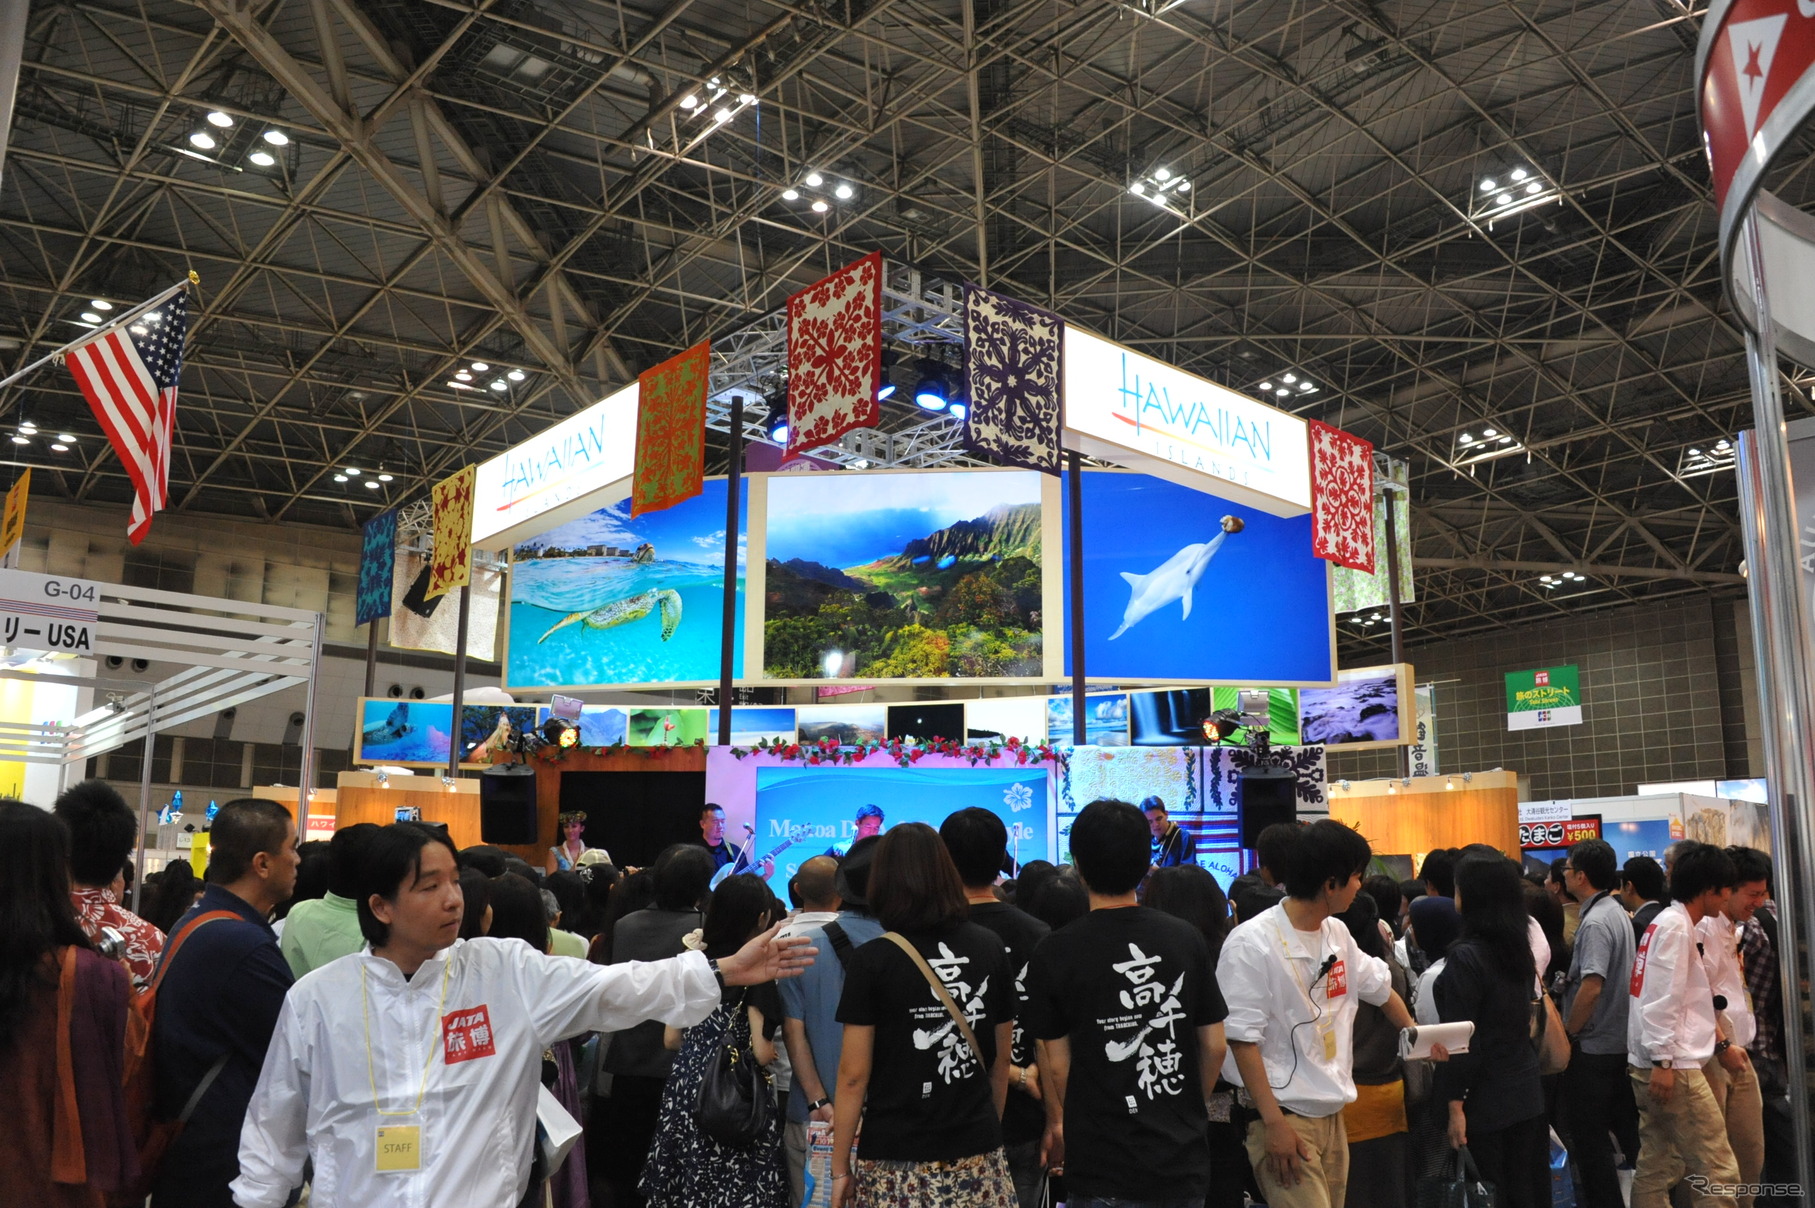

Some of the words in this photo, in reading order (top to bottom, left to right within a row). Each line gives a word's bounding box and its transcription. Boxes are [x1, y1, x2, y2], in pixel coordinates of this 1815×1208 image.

[1118, 352, 1271, 461] HAWAIIAN
[502, 413, 605, 514] HAWAIIAN
[1156, 441, 1249, 486] ISLANDS
[44, 580, 95, 602] G-04
[48, 623, 89, 650] USA
[1567, 829, 1596, 842] ¥500
[1208, 861, 1238, 879] ALOHA
[448, 1011, 485, 1030] JATA
[447, 1024, 490, 1052] 旅博
[384, 1143, 412, 1153] STAFF
